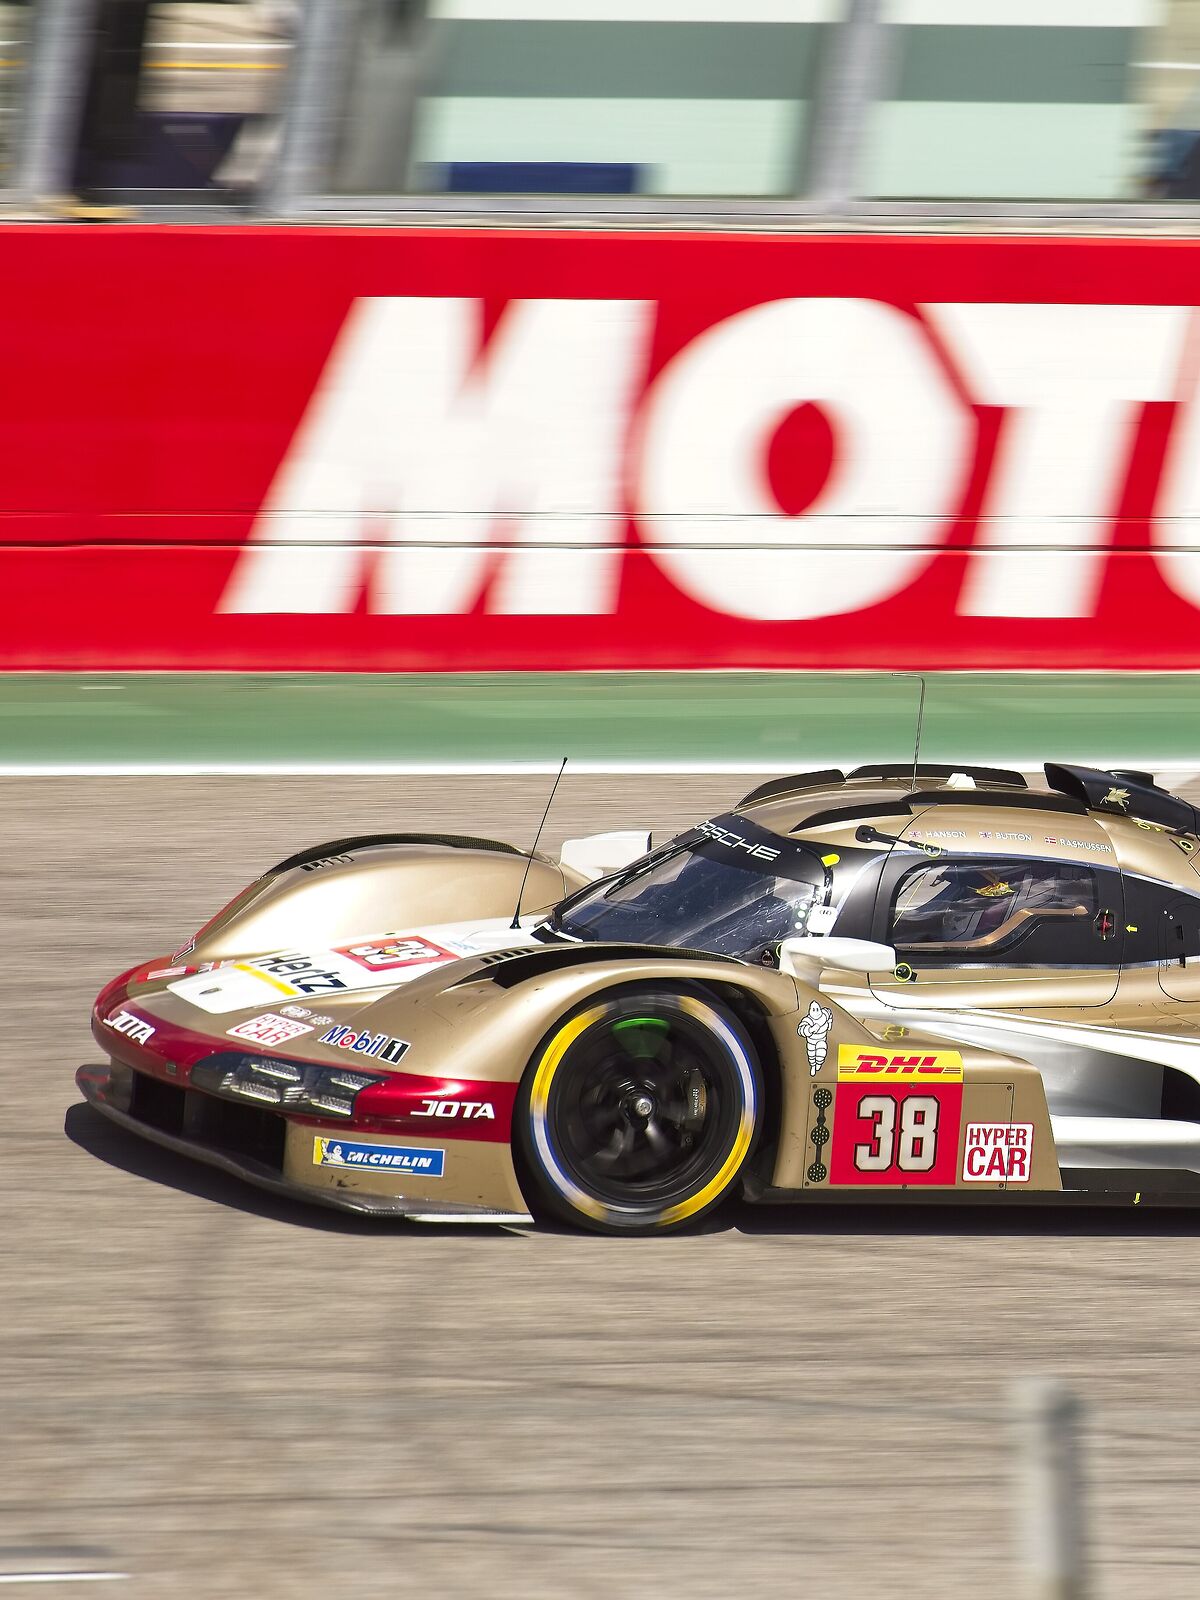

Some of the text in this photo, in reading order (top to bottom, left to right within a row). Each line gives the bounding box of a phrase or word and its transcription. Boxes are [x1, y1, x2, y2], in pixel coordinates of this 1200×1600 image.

[996, 832, 1032, 841] BUTTON
[1059, 838, 1112, 853] RASMUSSEN
[250, 952, 348, 993] Hertz
[103, 1010, 156, 1046] JOTA
[234, 1022, 290, 1044] CAR
[320, 1025, 387, 1056] Mobil
[855, 1054, 946, 1074] DHL
[410, 1100, 495, 1119] JOTA
[853, 1094, 941, 1173] 38
[968, 1127, 1027, 1146] HYPER
[347, 1152, 433, 1168] MICHELIN
[967, 1146, 1027, 1177] CAR
